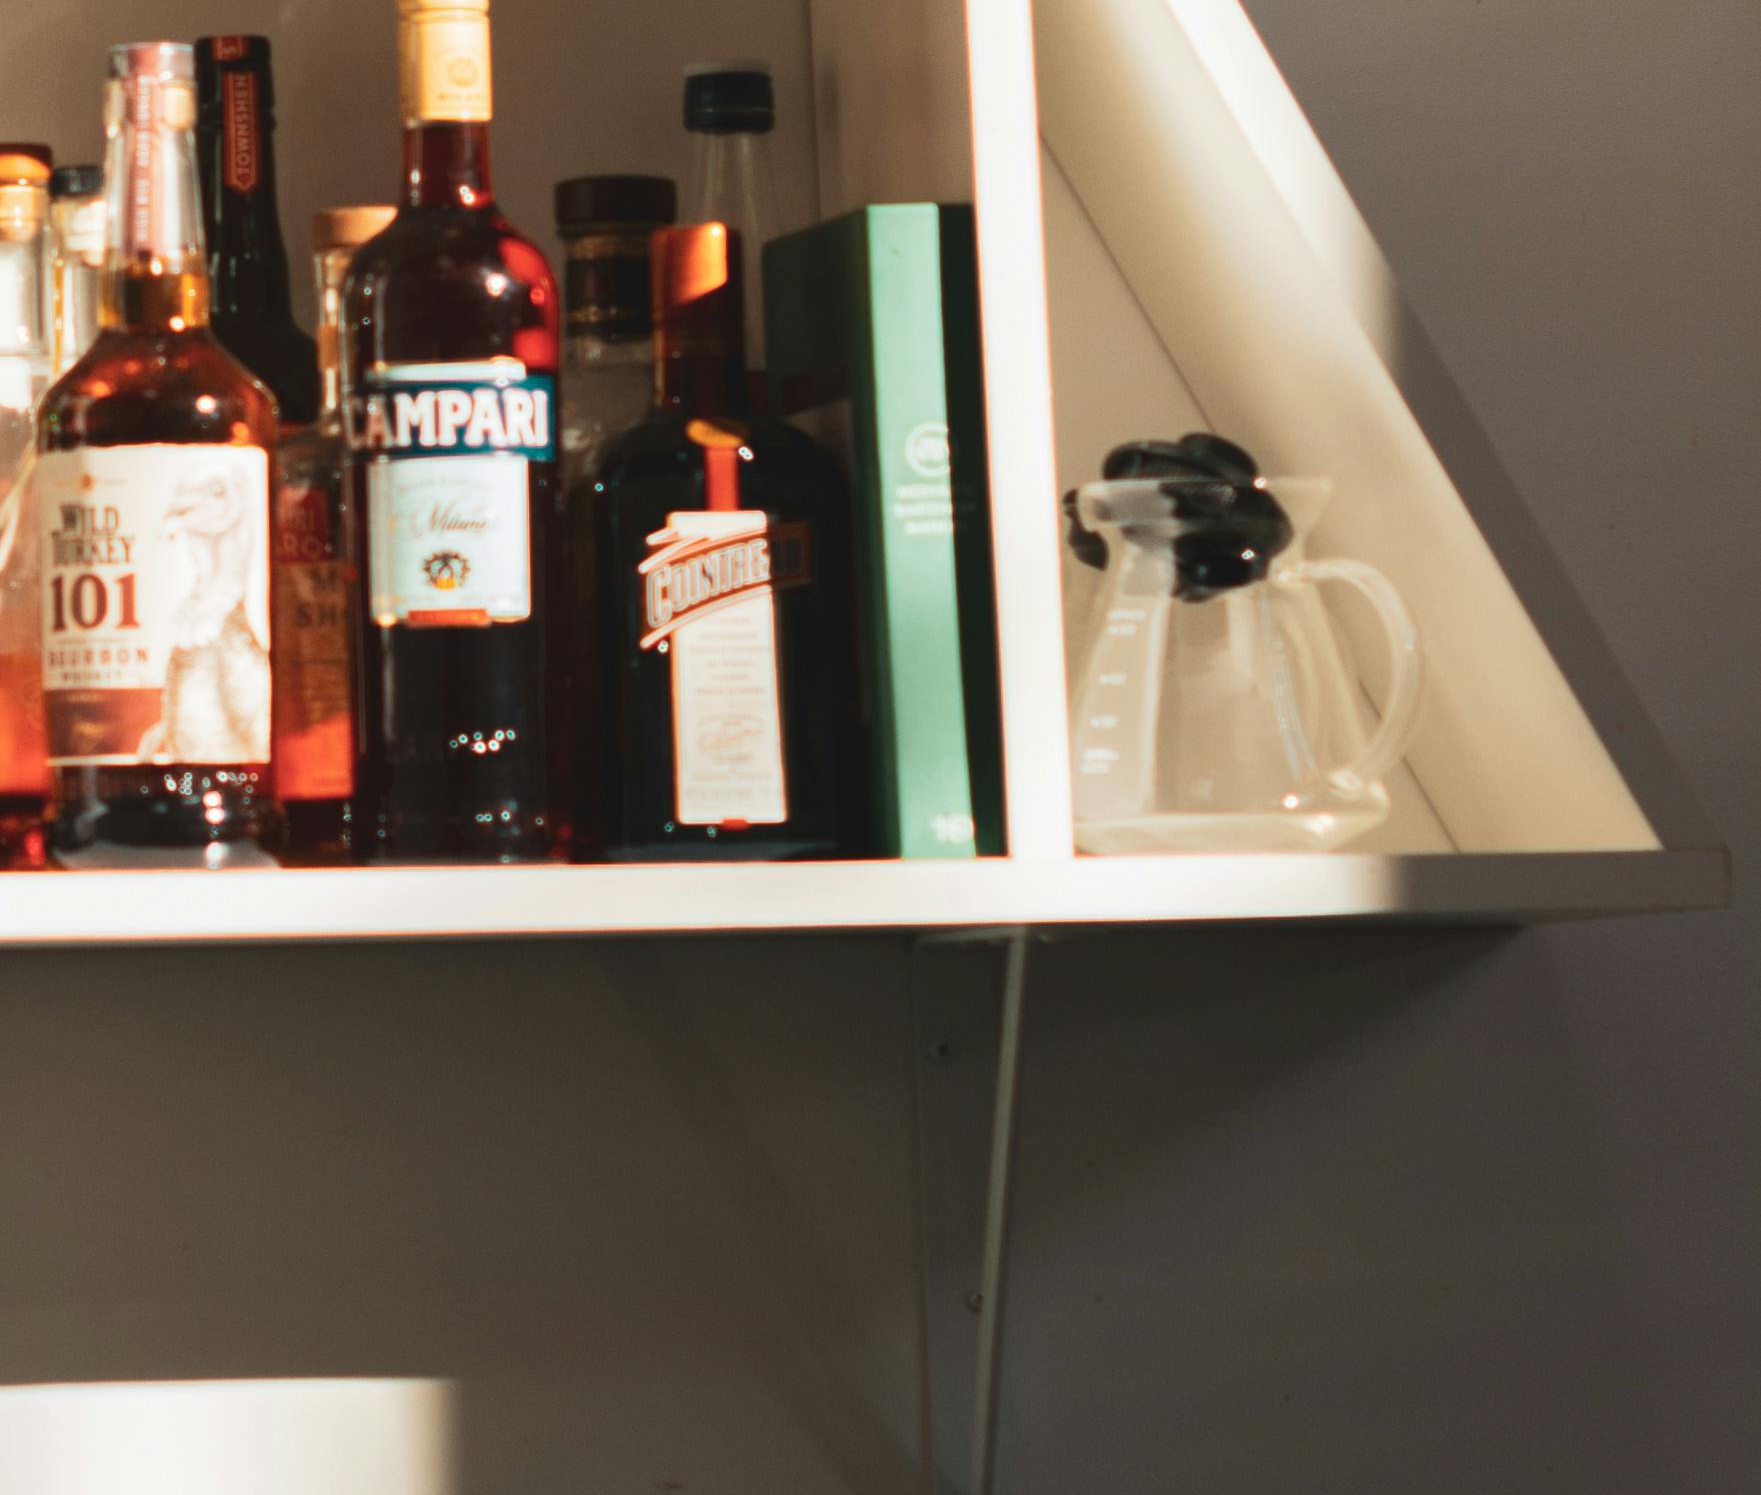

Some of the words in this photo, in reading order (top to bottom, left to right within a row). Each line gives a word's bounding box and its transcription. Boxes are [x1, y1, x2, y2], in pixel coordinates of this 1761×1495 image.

[348, 387, 549, 450] CAMPARI
[60, 502, 120, 532] WILD
[50, 529, 136, 566] TURKEY
[51, 573, 141, 632] 101
